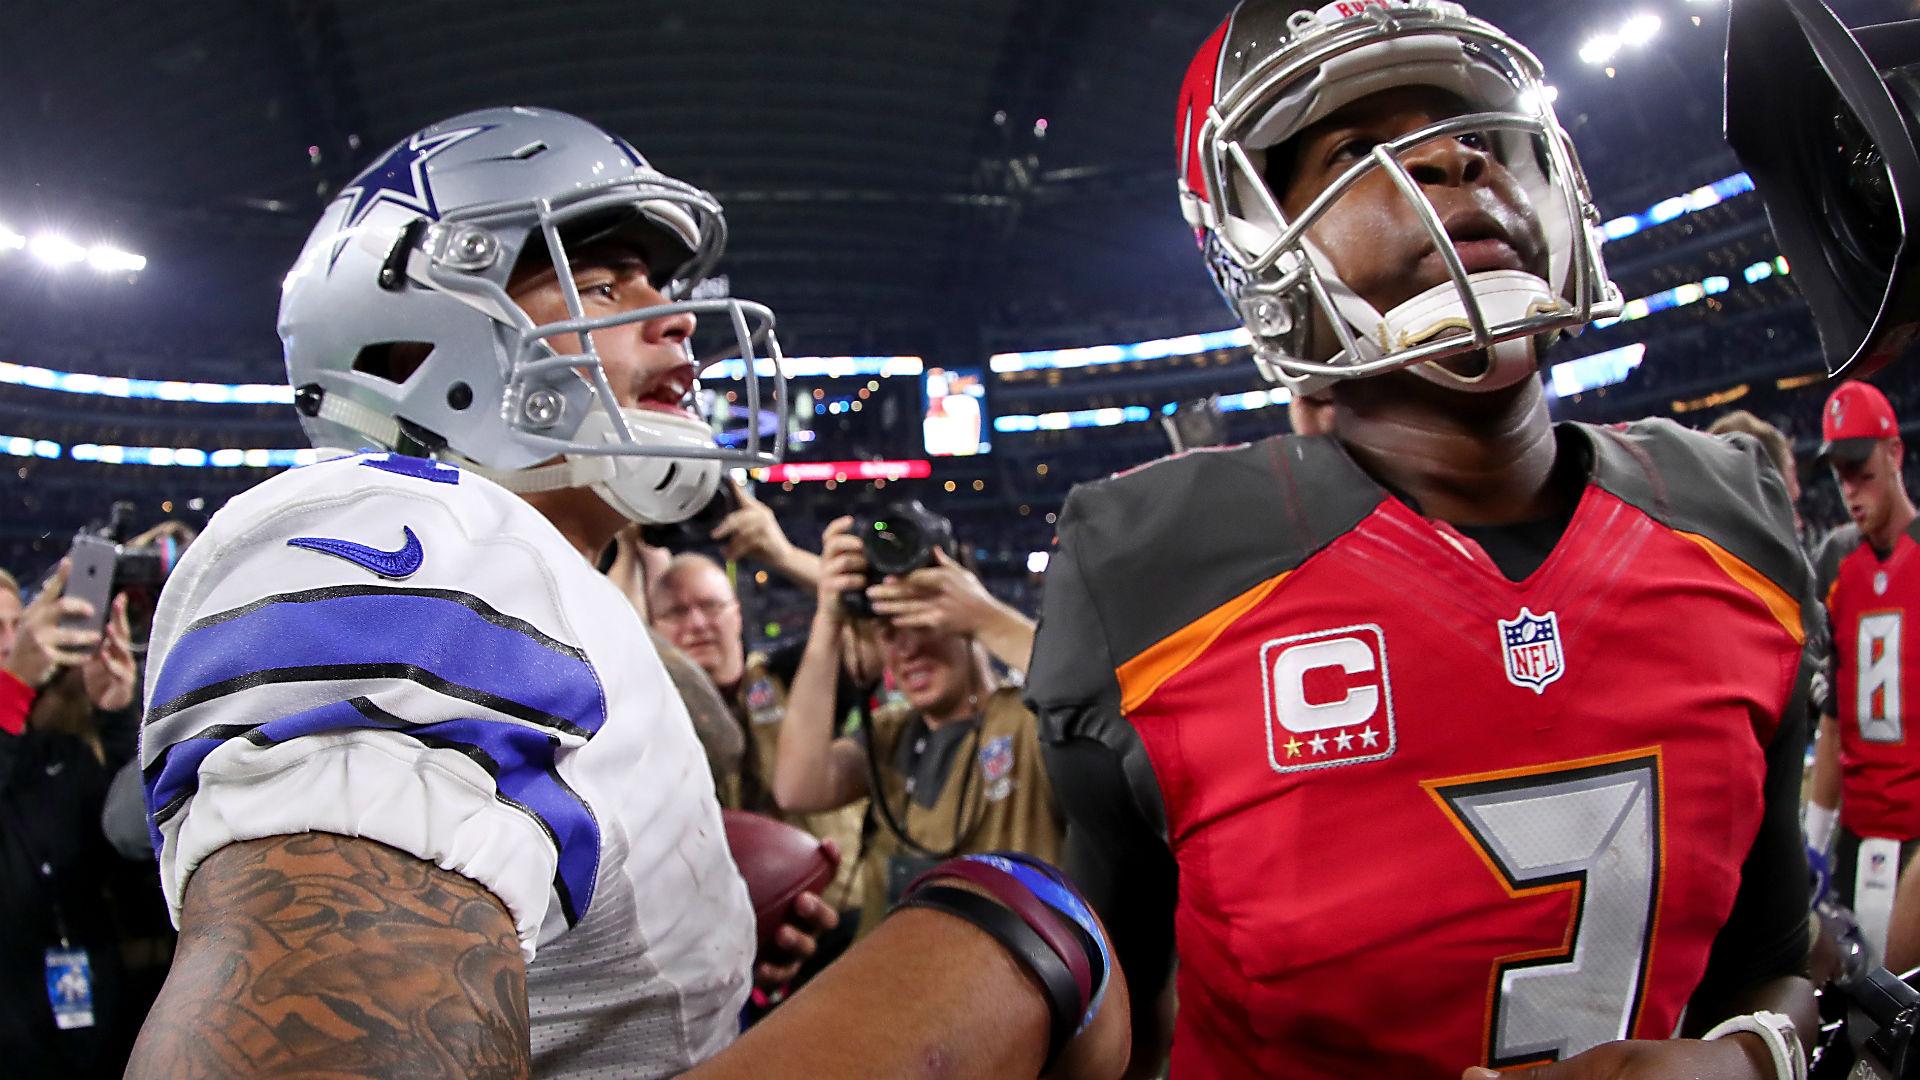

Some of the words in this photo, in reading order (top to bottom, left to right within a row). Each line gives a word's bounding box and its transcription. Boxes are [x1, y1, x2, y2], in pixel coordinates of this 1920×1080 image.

[1273, 637, 1379, 733] C
[1512, 643, 1556, 678] NFL
[1857, 611, 1903, 745] 8
[1419, 745, 1665, 1072] 3
